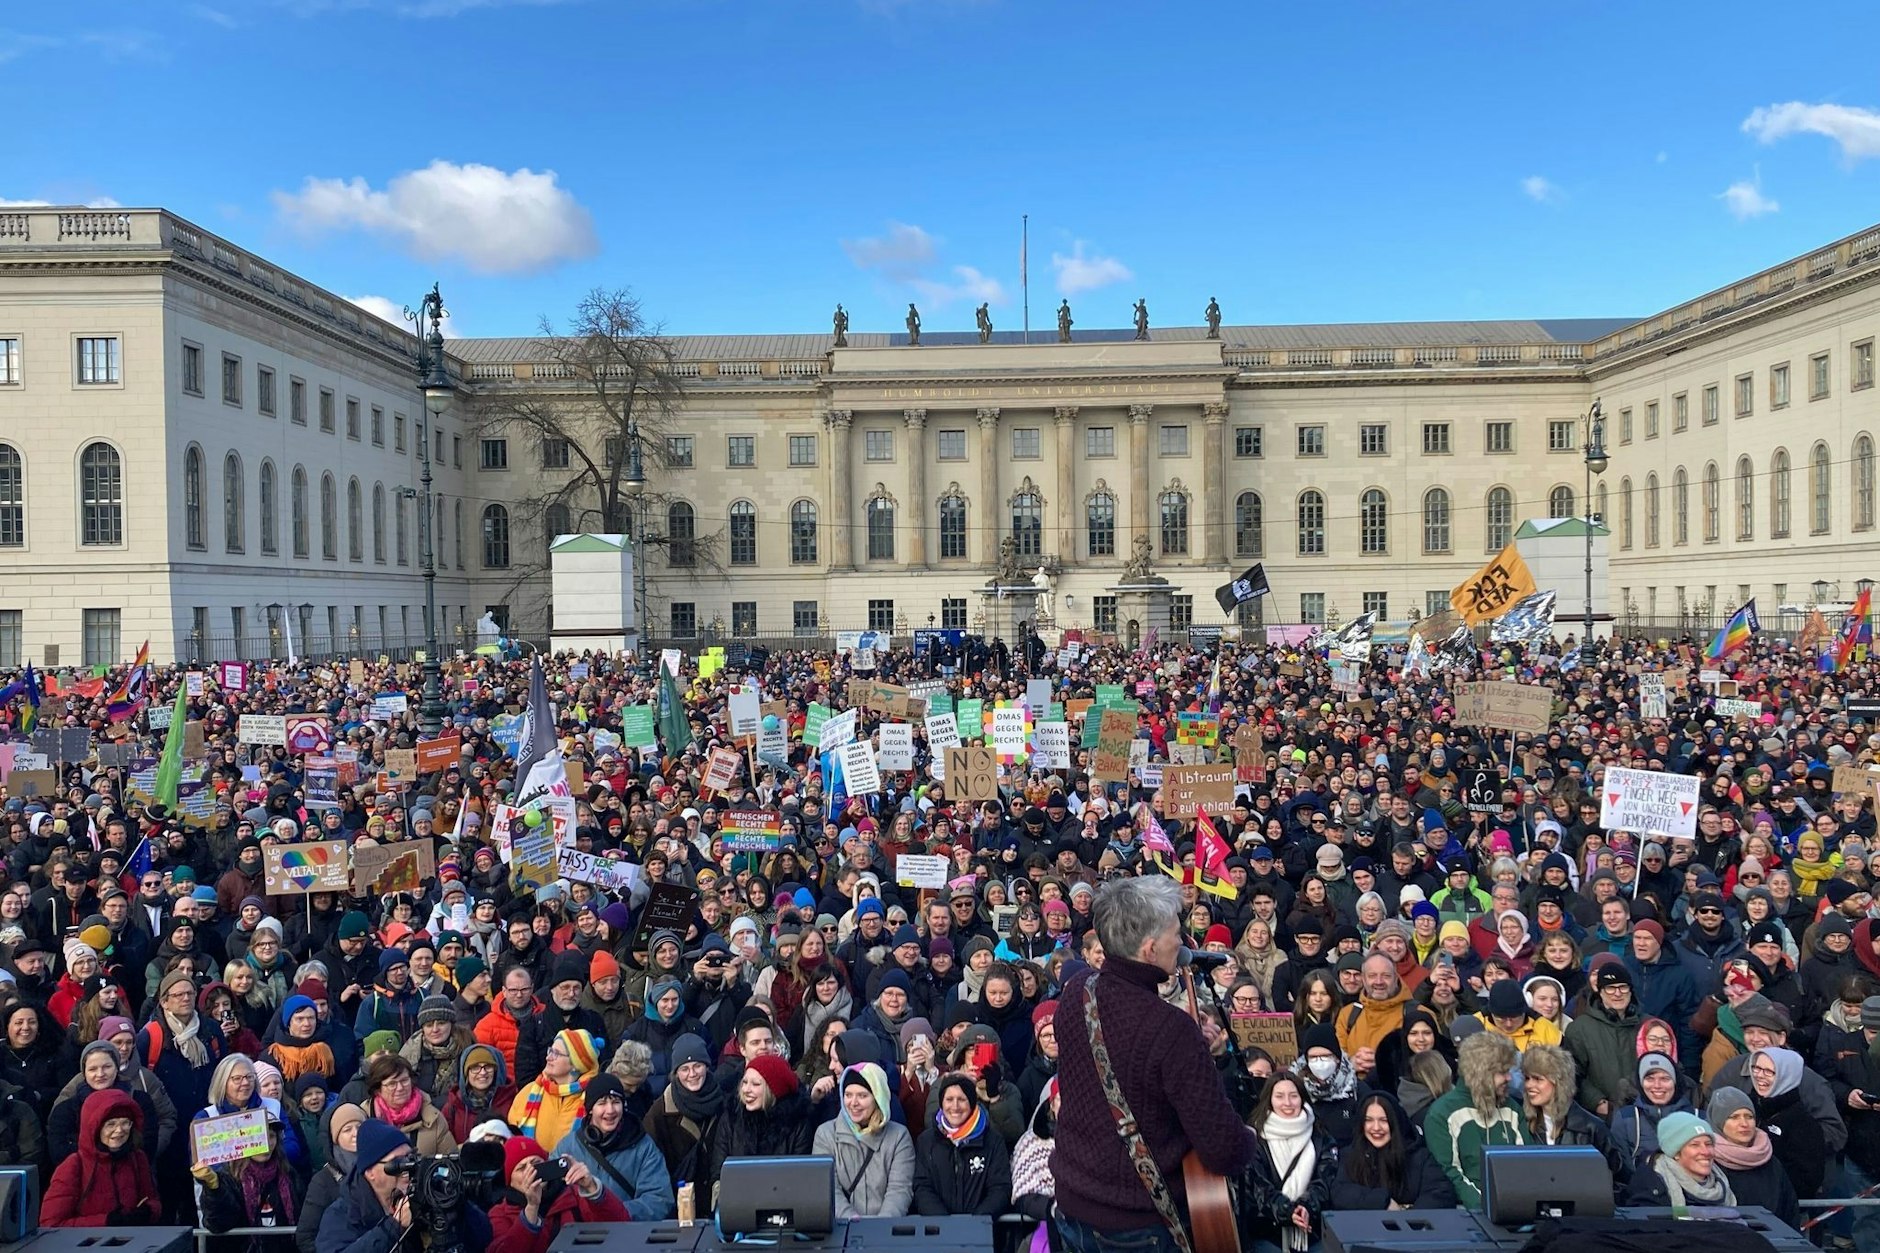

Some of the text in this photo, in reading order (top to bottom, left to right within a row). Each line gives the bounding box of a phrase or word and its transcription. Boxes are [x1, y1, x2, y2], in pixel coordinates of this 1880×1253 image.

[883, 388, 994, 397] HUMBOLDT
[930, 717, 951, 728] OMAS
[931, 726, 954, 736] GEGEN
[931, 734, 958, 745] RECHTS
[847, 744, 864, 752] OMAS
[847, 751, 867, 759] GEGEN
[1041, 750, 1068, 758] ECHTS
[847, 758, 870, 766] RECHTS
[1168, 770, 1232, 785] Albtraum
[1171, 788, 1193, 800] für
[1623, 787, 1677, 805] FINGER WEG
[1170, 800, 1236, 815] Deutschland
[1623, 800, 1677, 817] VON UNSERER
[729, 812, 775, 822] MENSCHEN
[1621, 813, 1673, 832] DEMOKRATIE
[735, 821, 766, 829] RECHTE
[735, 835, 766, 843] RECHTE
[727, 841, 772, 850] MENSCHEN
[558, 850, 590, 871] HASS
[284, 864, 326, 878] VIELFALT
[1243, 1018, 1292, 1029] EVOLUTION
[1248, 1032, 1295, 1046] GEWOLLT,
